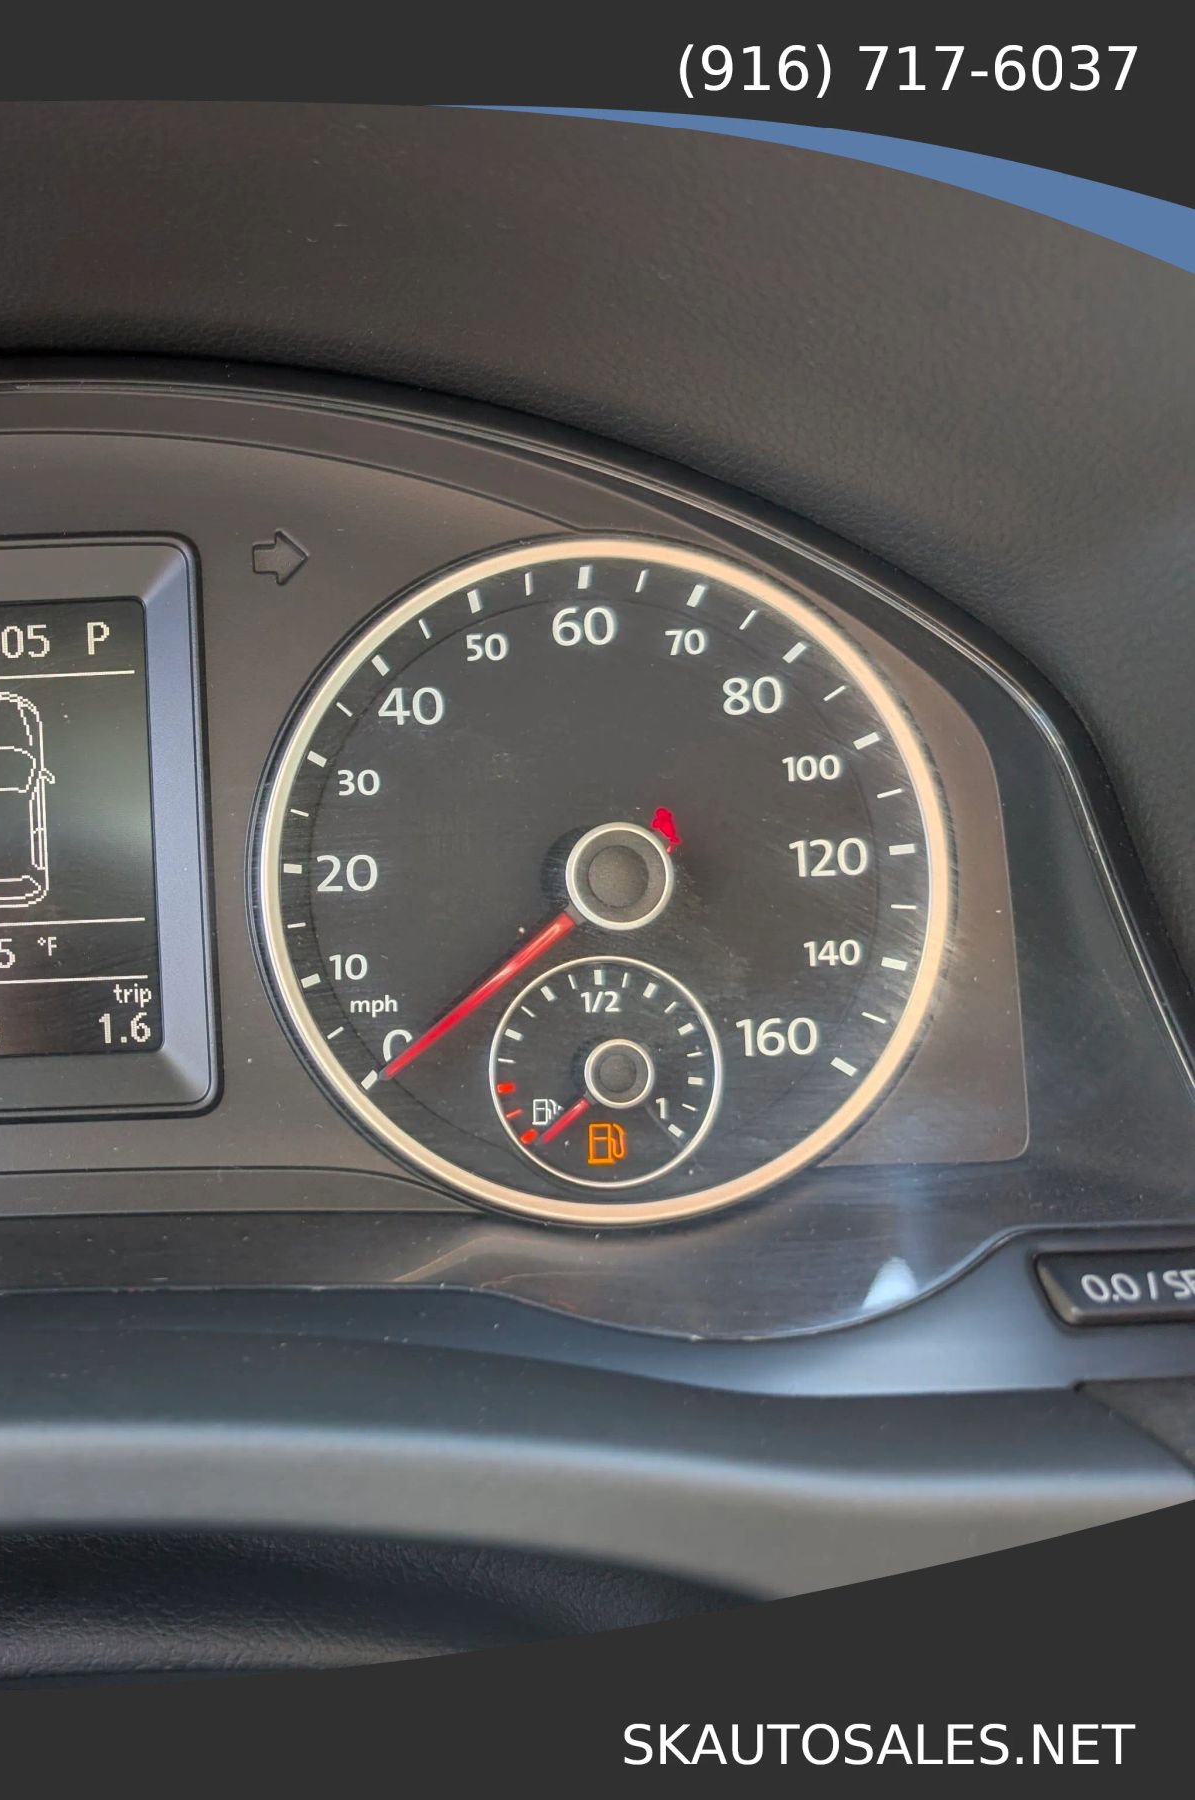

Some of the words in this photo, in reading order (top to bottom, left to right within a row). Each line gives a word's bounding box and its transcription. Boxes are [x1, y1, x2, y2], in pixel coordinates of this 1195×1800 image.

[87, 622, 110, 655] P
[552, 607, 617, 646] 60
[465, 634, 507, 662] 50
[665, 630, 705, 655] 70
[378, 688, 444, 726] 40
[722, 677, 782, 714] 80
[782, 755, 840, 781] 100
[337, 770, 380, 796] 30
[788, 837, 867, 876] 120
[316, 855, 377, 891] 20
[38, 936, 58, 957] °F
[804, 941, 861, 965] 140
[329, 954, 367, 979] 10
[114, 983, 152, 1007] trip
[350, 994, 398, 1018] mph
[581, 991, 621, 1013] 1/2
[100, 1013, 151, 1043] 1.6
[736, 1018, 818, 1056] 160
[656, 1097, 667, 1120] 1
